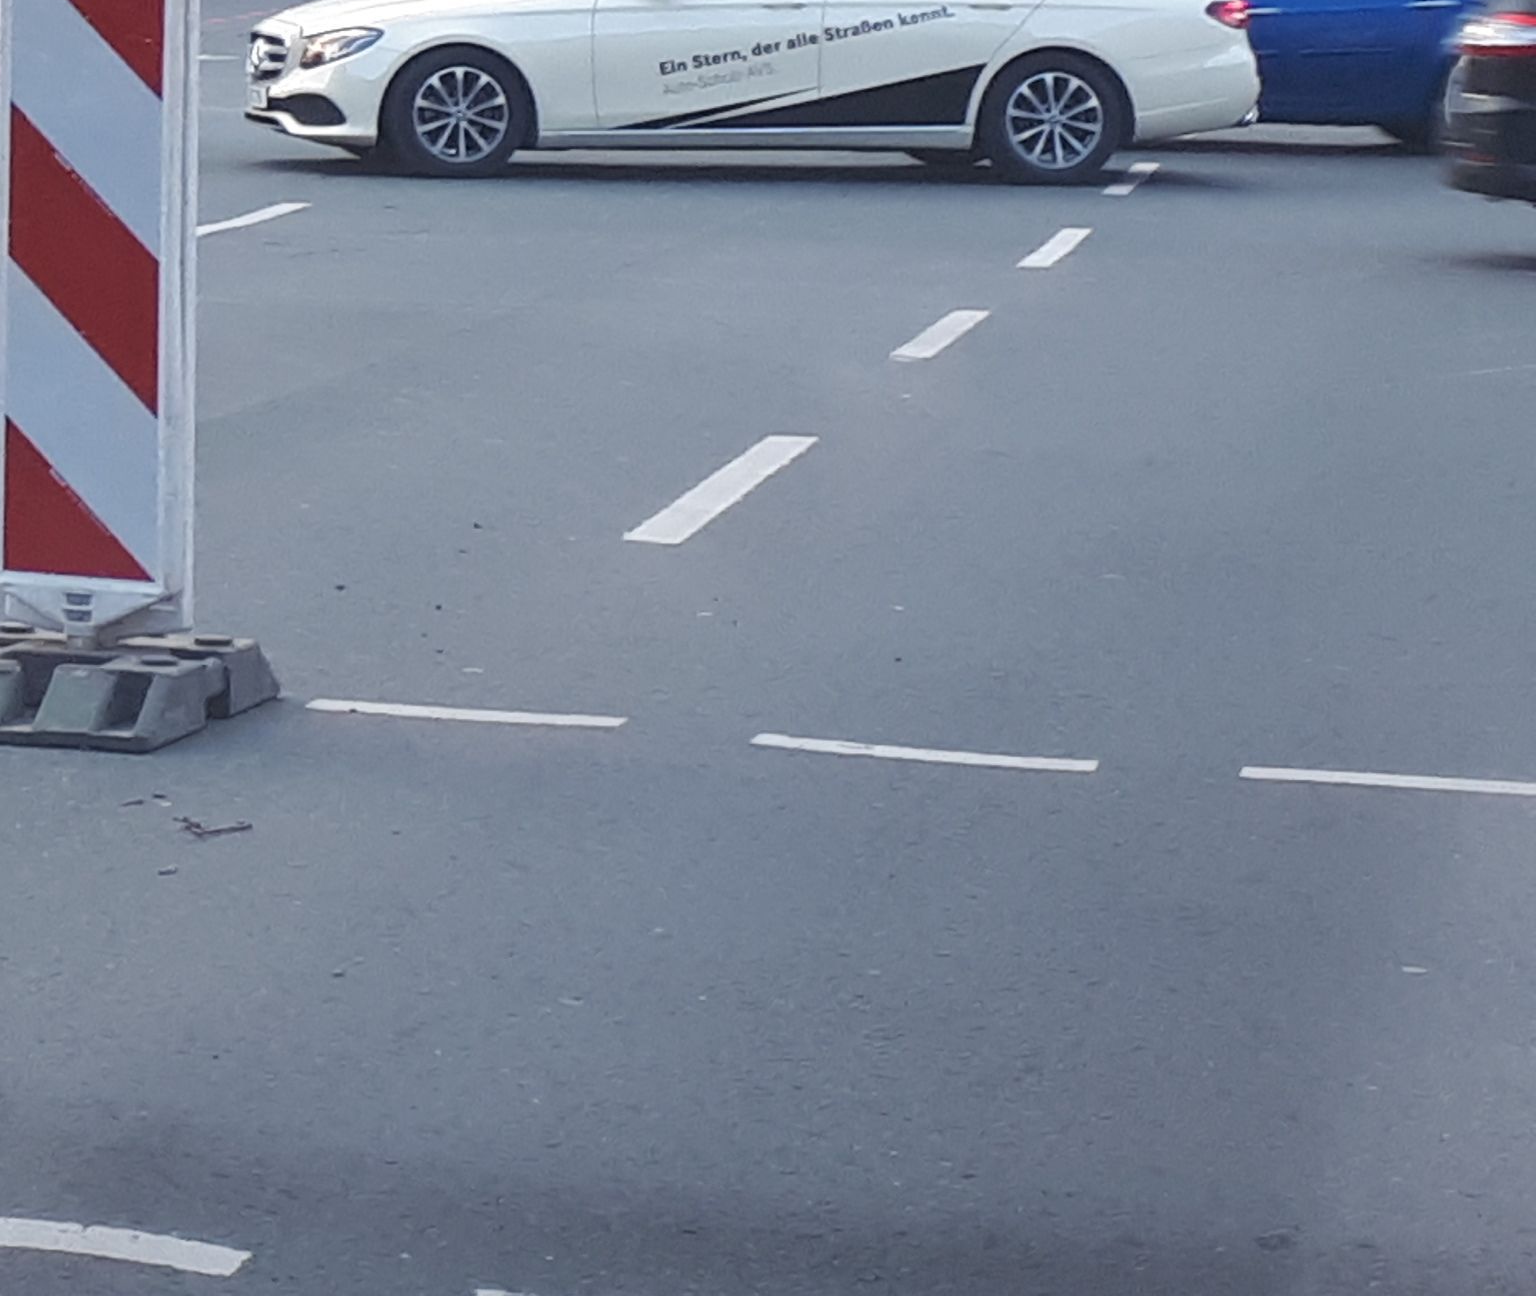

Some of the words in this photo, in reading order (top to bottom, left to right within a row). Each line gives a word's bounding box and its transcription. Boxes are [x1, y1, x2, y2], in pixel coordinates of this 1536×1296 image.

[659, 60, 688, 76] Ein
[692, 47, 748, 70] Stern,
[751, 39, 781, 57] der
[786, 32, 819, 51] alle
[824, 19, 894, 43] Straßen
